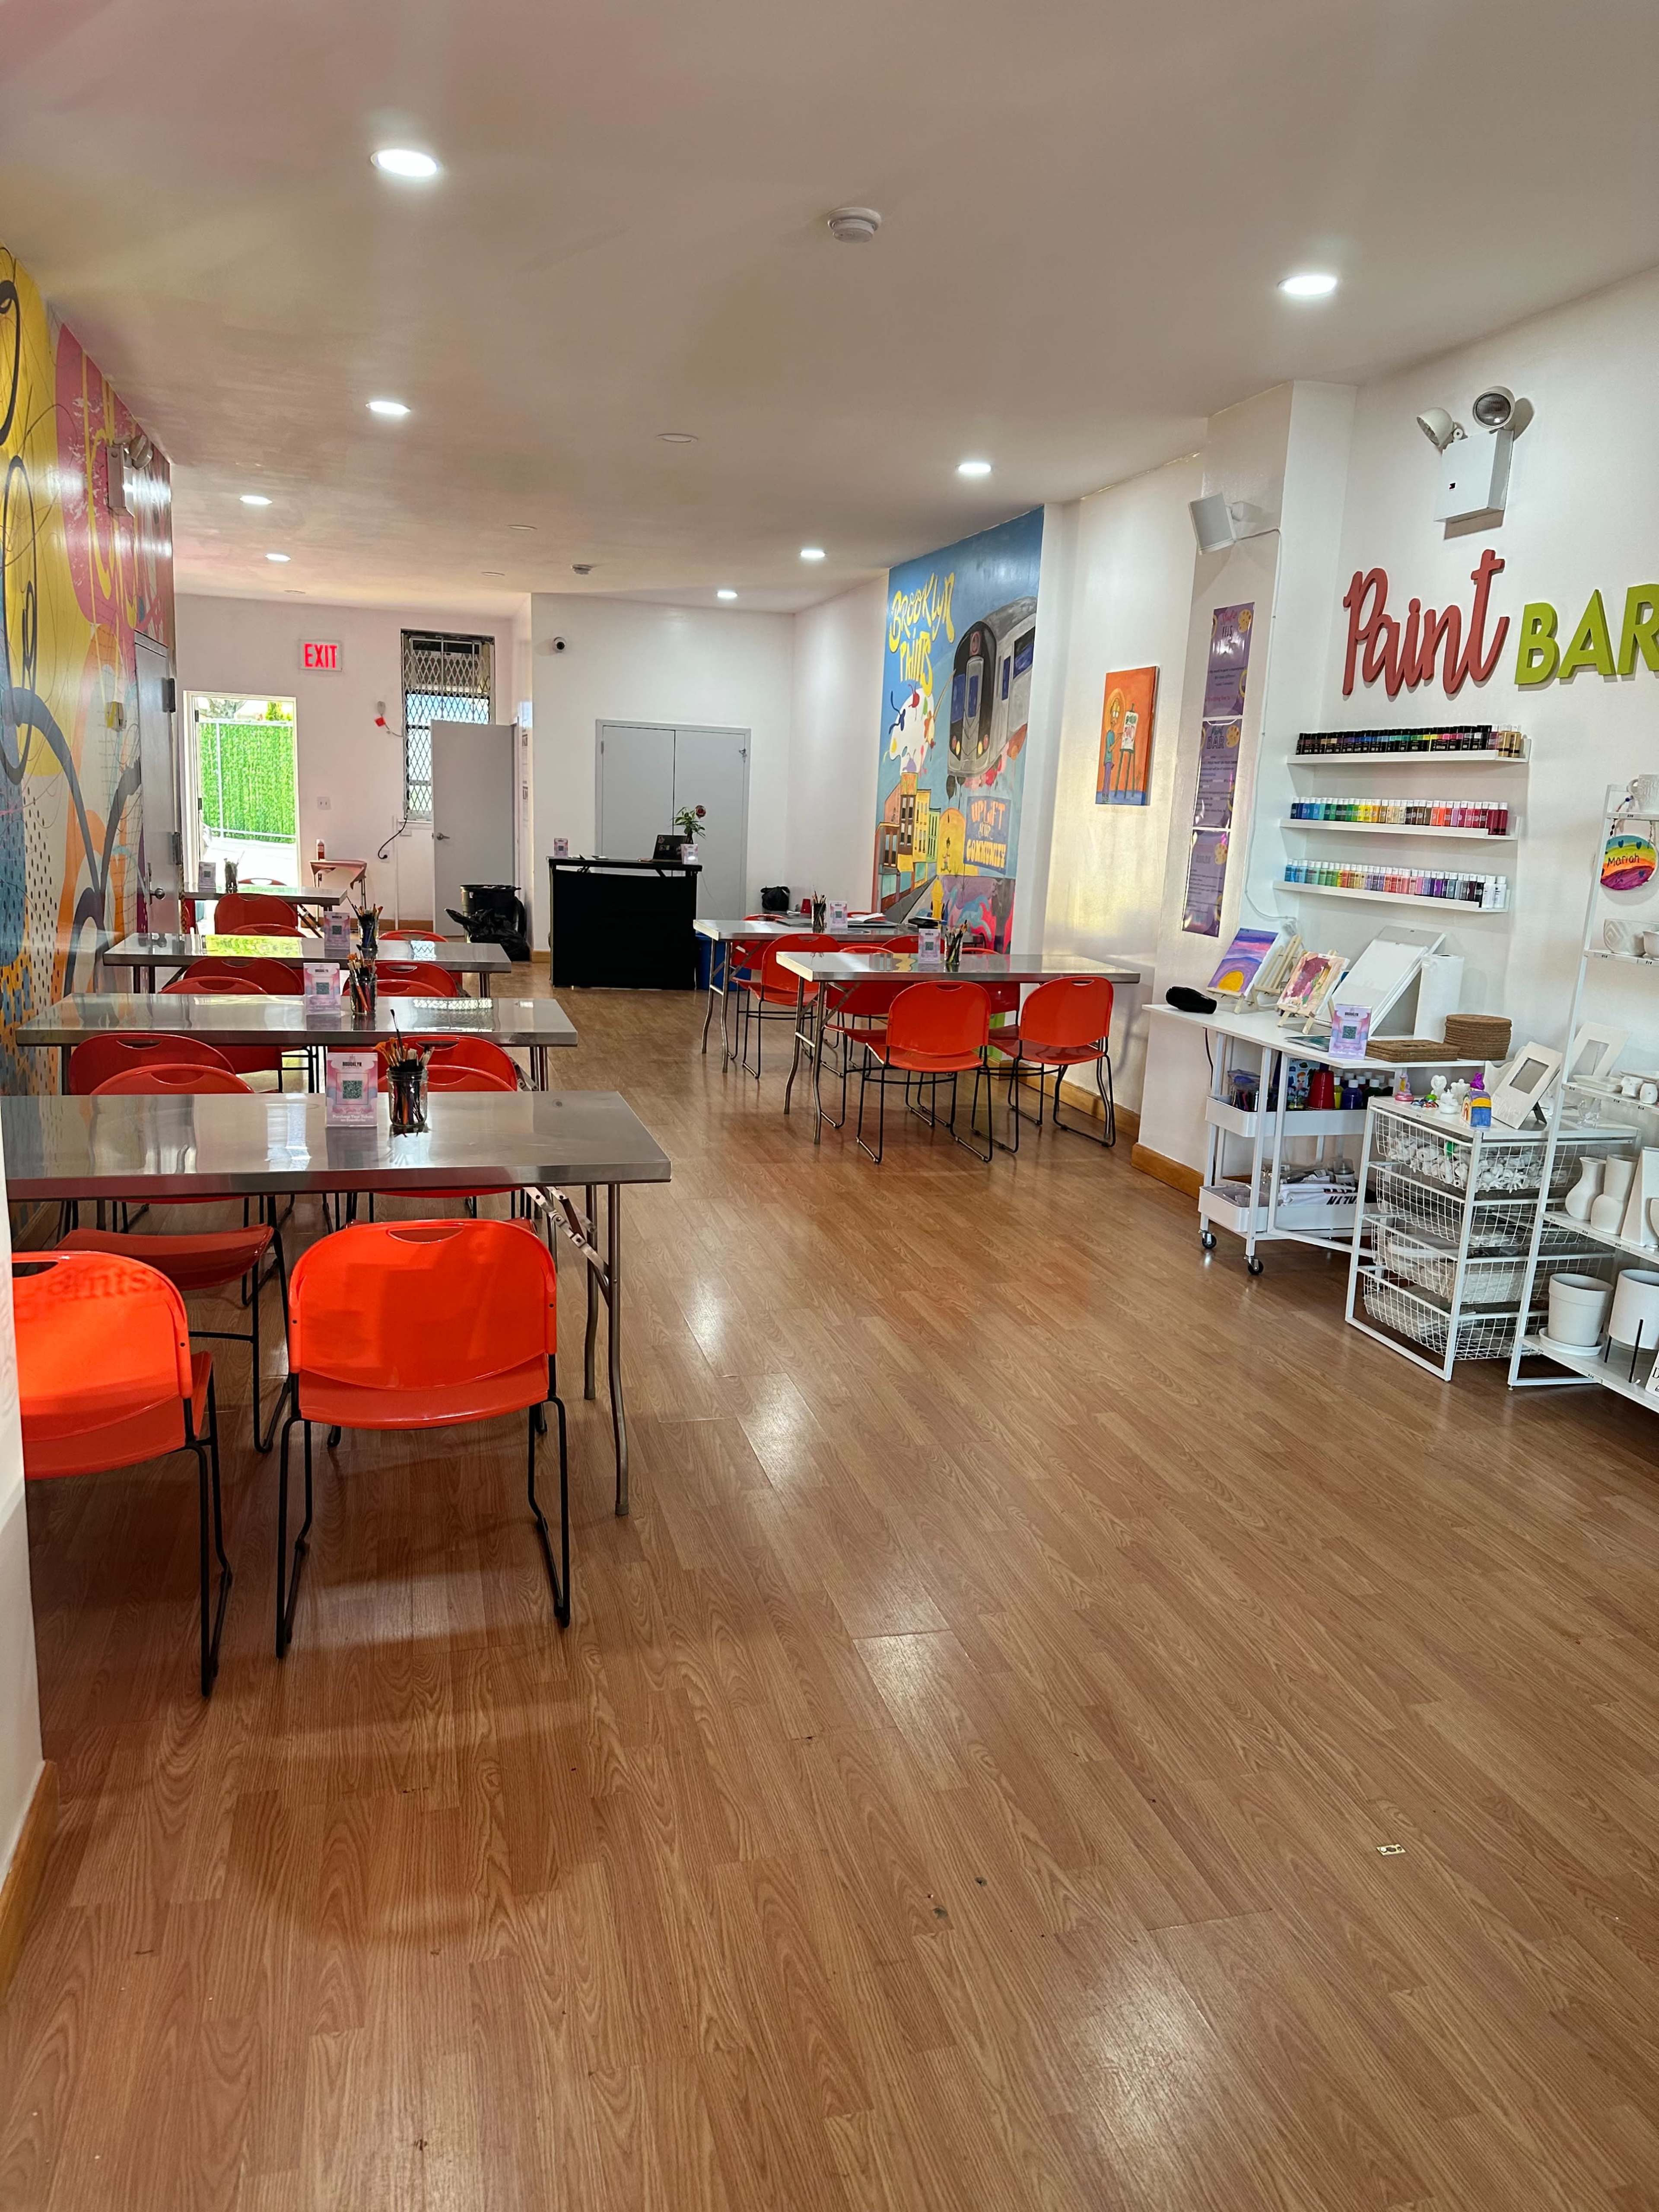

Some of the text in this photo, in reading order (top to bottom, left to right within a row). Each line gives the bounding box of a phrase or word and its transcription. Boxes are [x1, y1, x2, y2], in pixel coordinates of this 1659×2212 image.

[1342, 549, 1659, 696] Paint BAR
[305, 643, 338, 668] EXIT
[1206, 736, 1224, 749] BAR
[1607, 852, 1640, 868] Mariah
